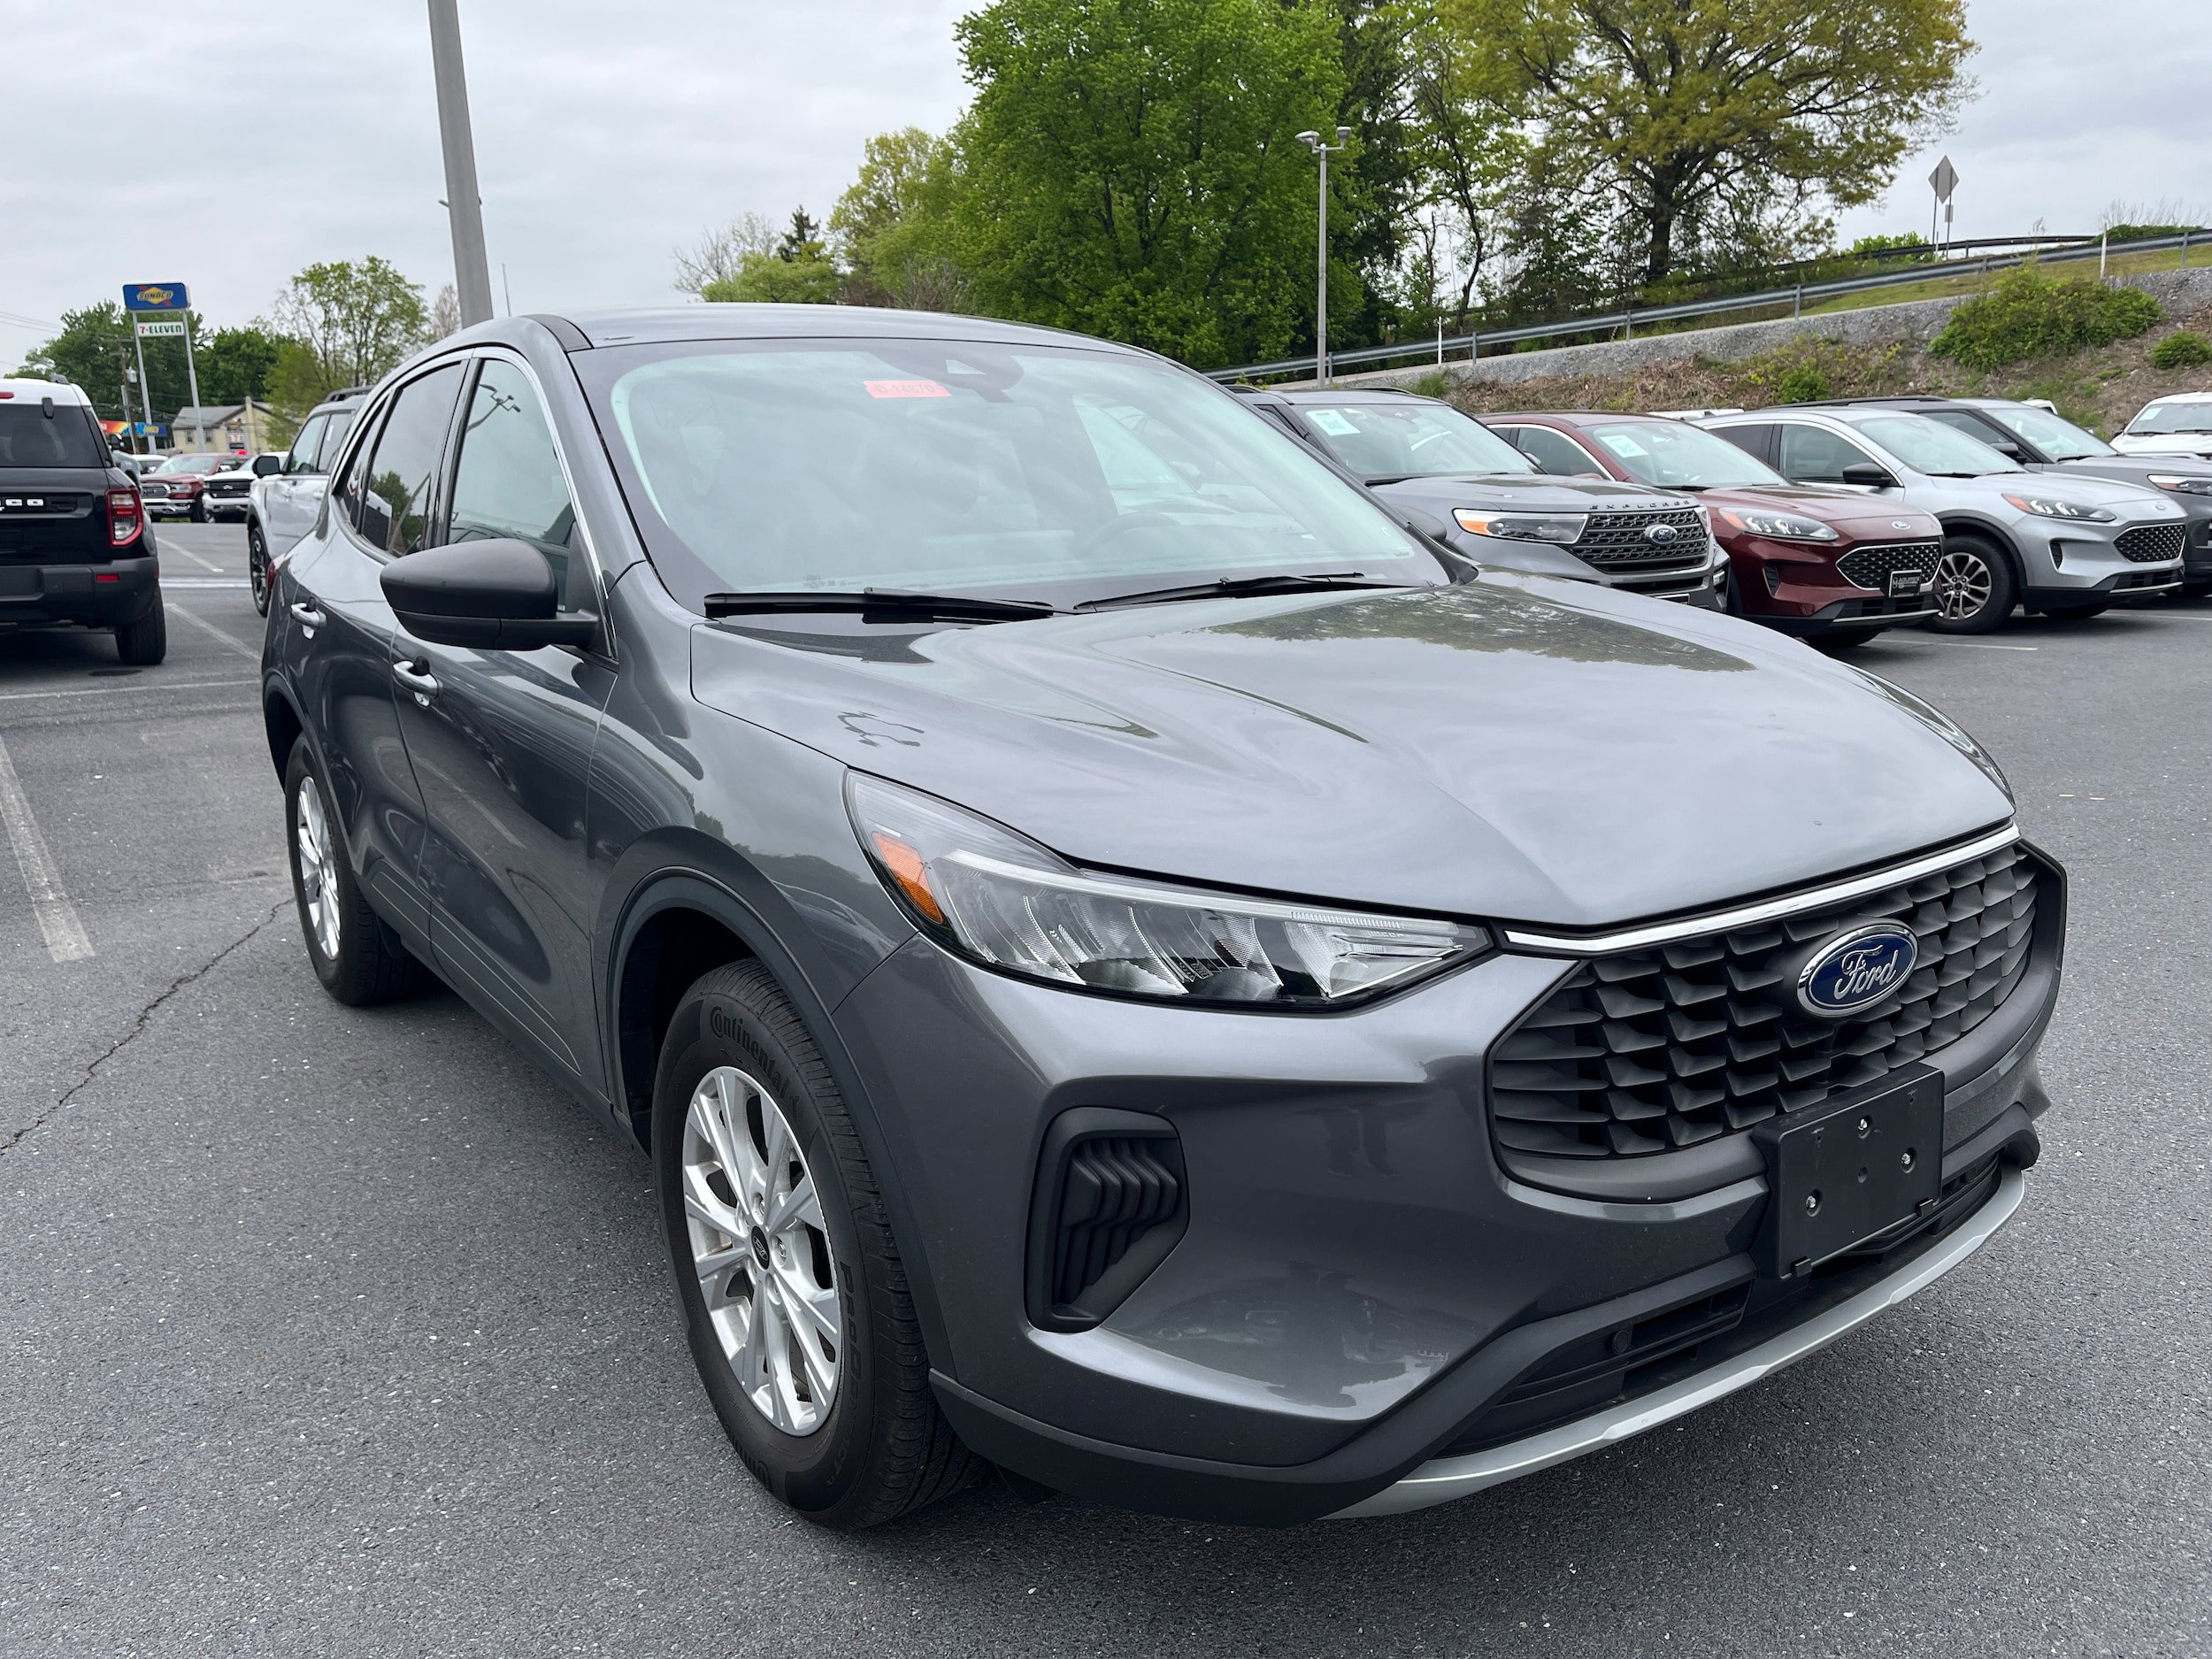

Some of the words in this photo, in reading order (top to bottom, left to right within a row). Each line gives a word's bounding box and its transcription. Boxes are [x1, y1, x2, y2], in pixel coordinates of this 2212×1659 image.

[138, 290, 173, 300] SUNOCO
[1589, 500, 1691, 511] EXPLORER
[1833, 944, 1899, 1000] Ford
[709, 1005, 791, 1099] Continental
